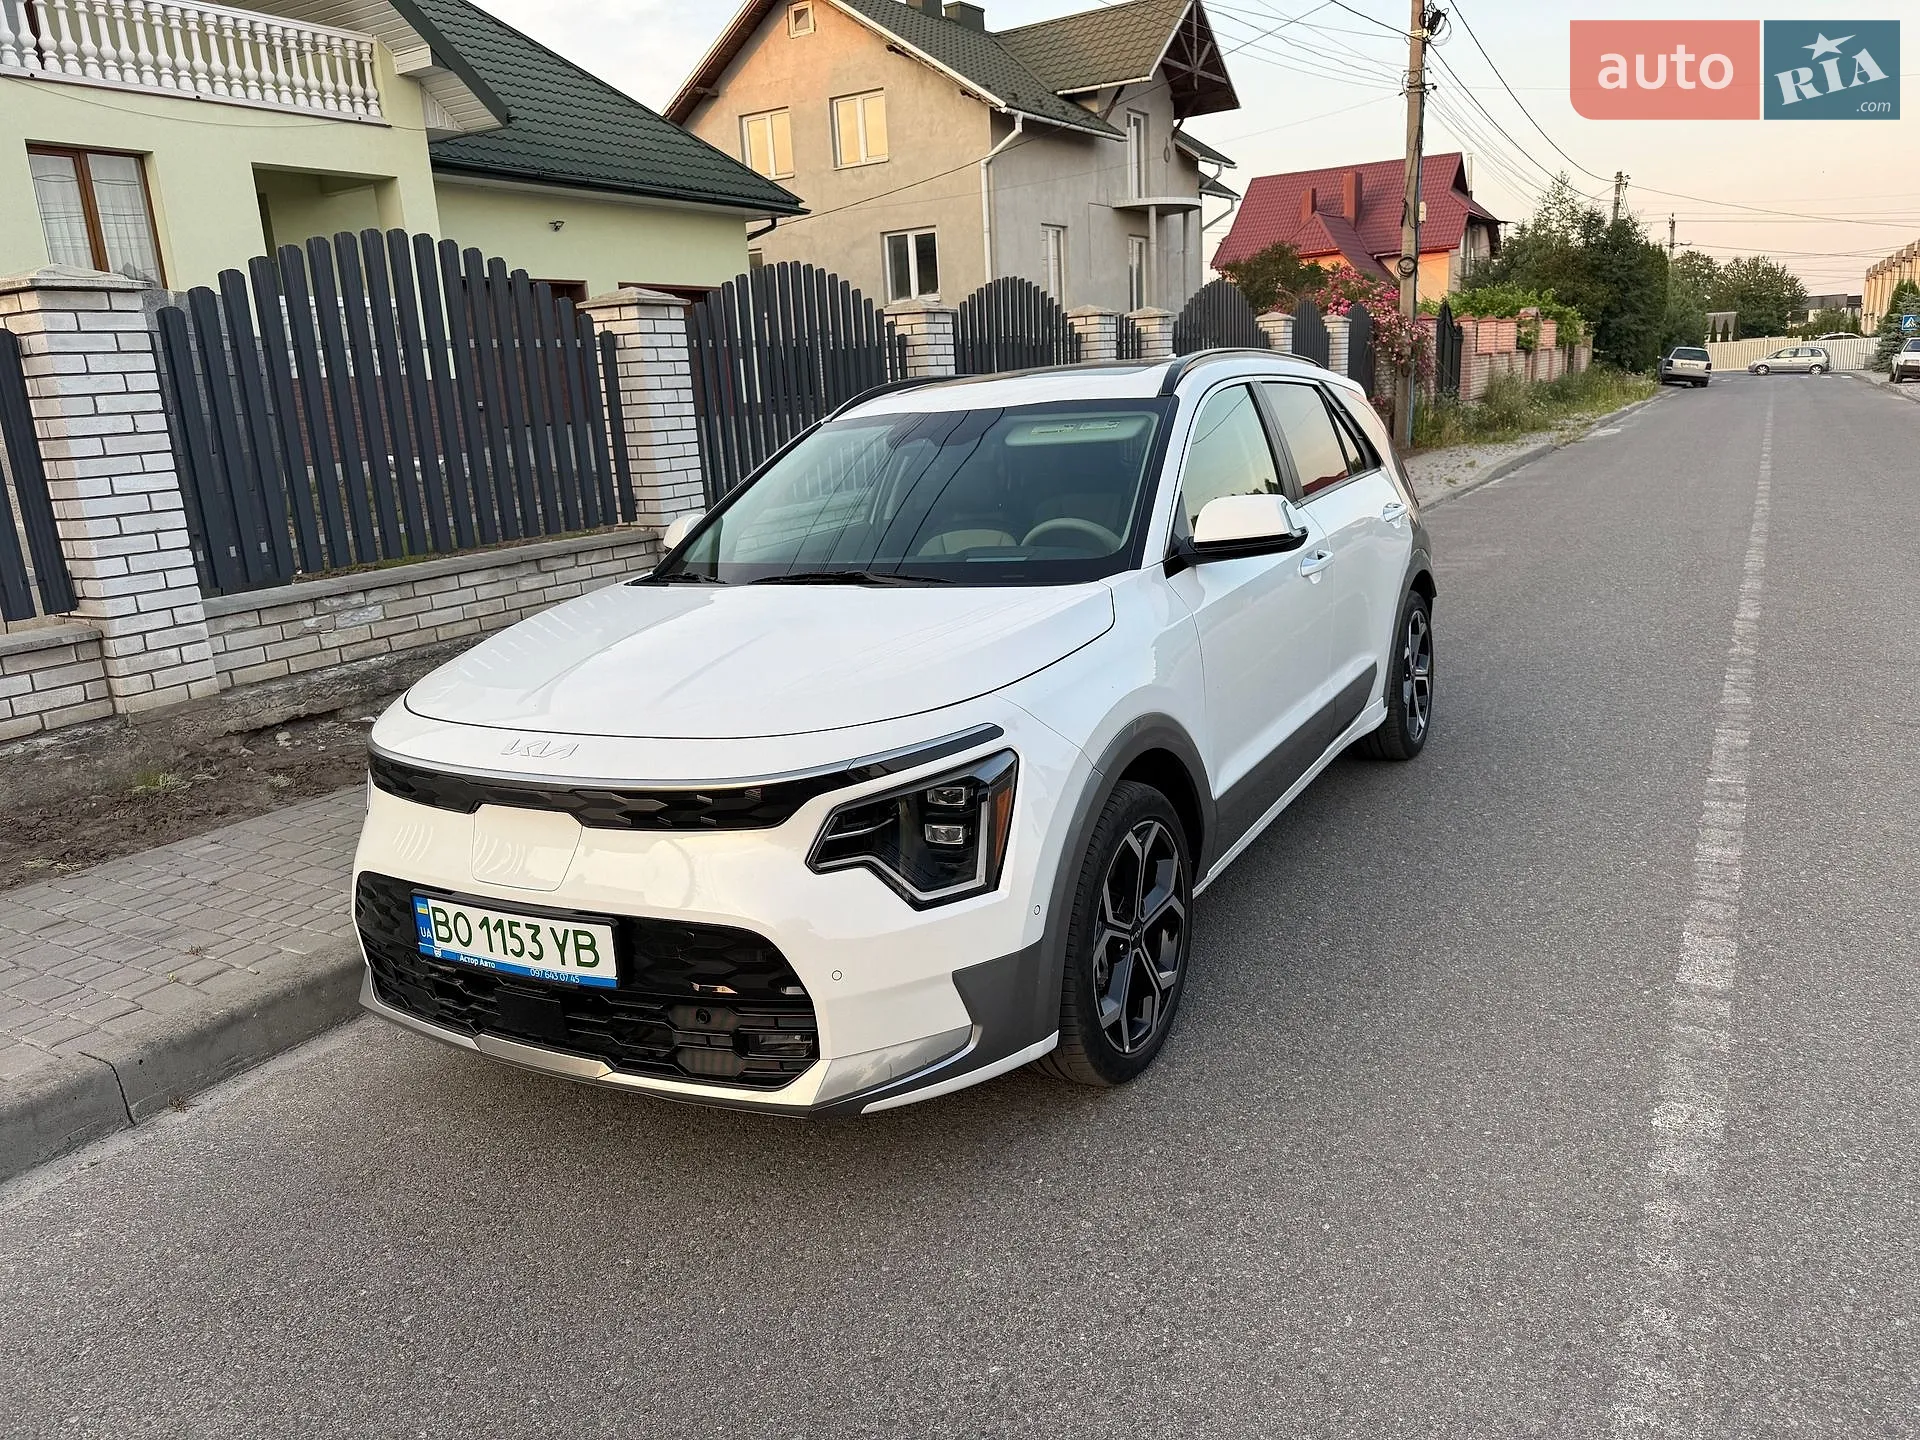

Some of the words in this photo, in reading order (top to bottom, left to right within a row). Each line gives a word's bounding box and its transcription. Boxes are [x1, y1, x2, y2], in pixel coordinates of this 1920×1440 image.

[500, 737, 580, 760] KIA
[420, 926, 433, 939] UA
[431, 906, 473, 947] BO
[478, 916, 544, 961] 1153
[549, 926, 600, 968] YB
[459, 954, 479, 966] Астор
[479, 958, 496, 969] Авто
[530, 968, 544, 978] 097
[560, 972, 569, 982] 07
